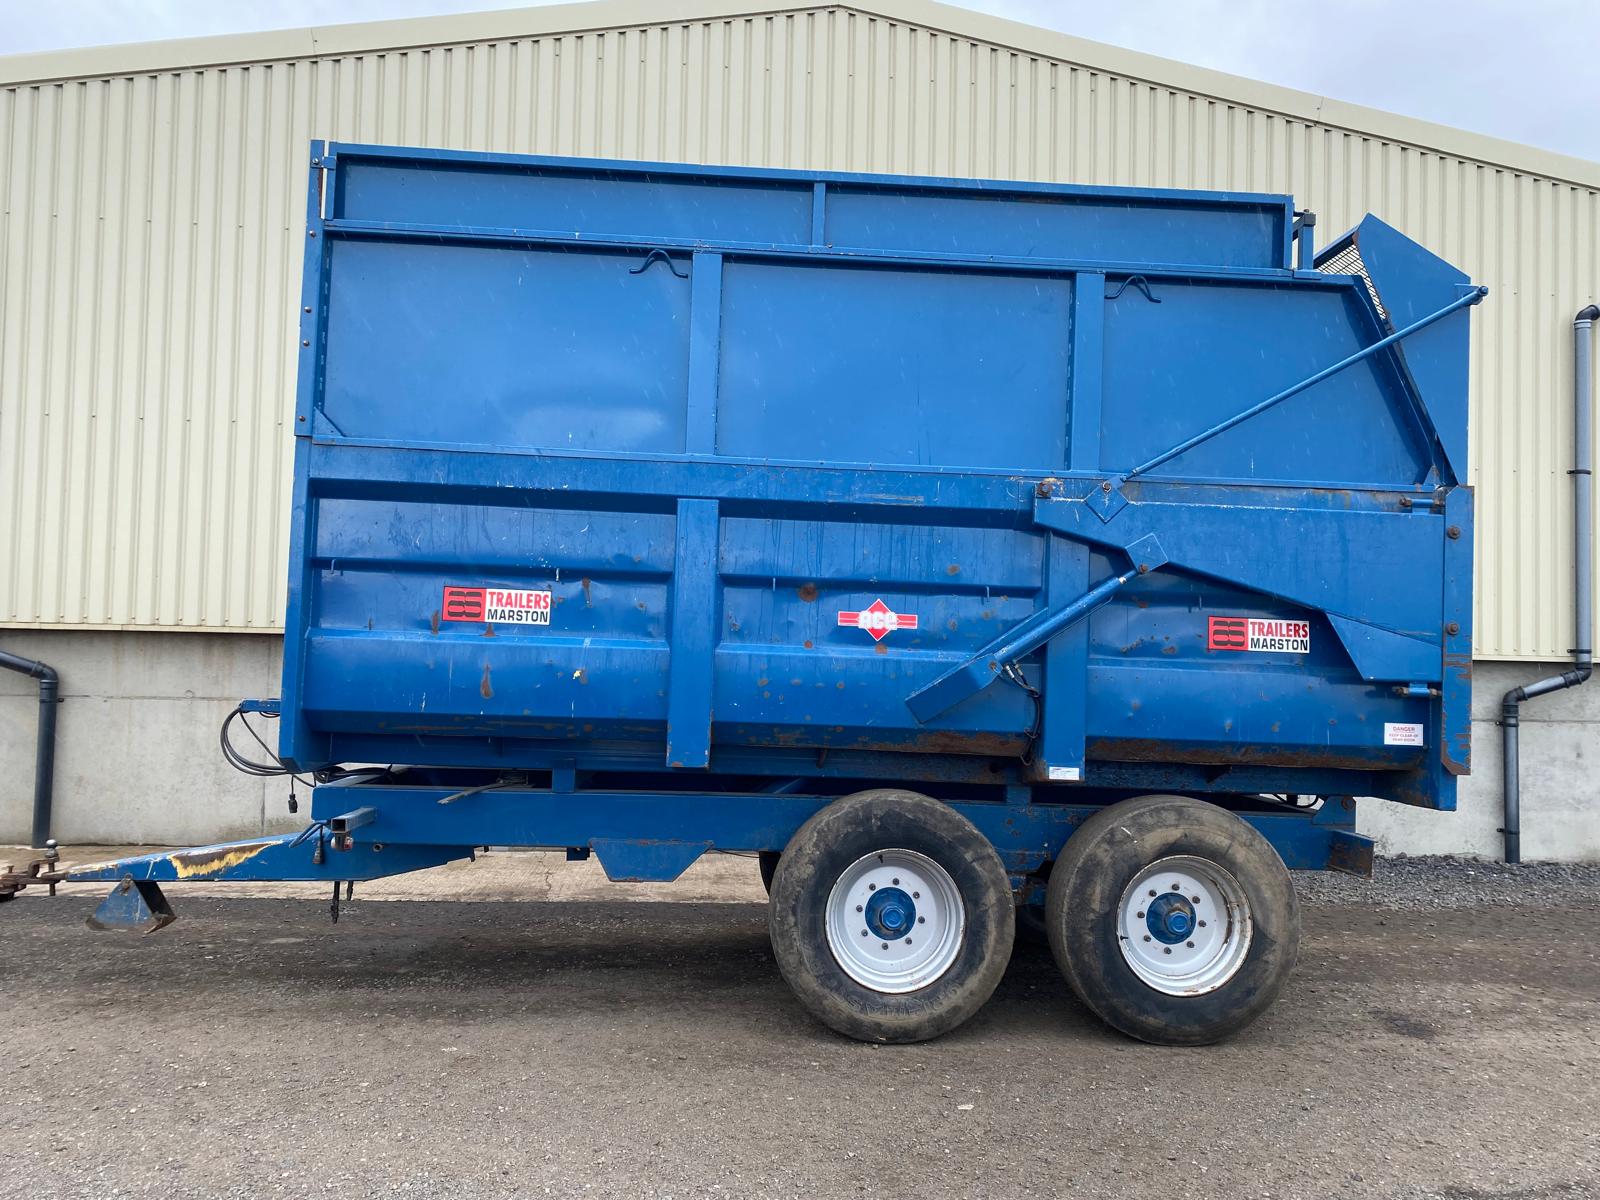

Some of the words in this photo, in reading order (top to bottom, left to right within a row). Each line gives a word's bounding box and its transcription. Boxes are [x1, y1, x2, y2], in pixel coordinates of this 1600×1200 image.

[488, 591, 550, 610] TRAILERS
[487, 609, 549, 623] MARSTON
[1250, 621, 1309, 638] TRAILERS
[1250, 637, 1308, 651] MARSTON
